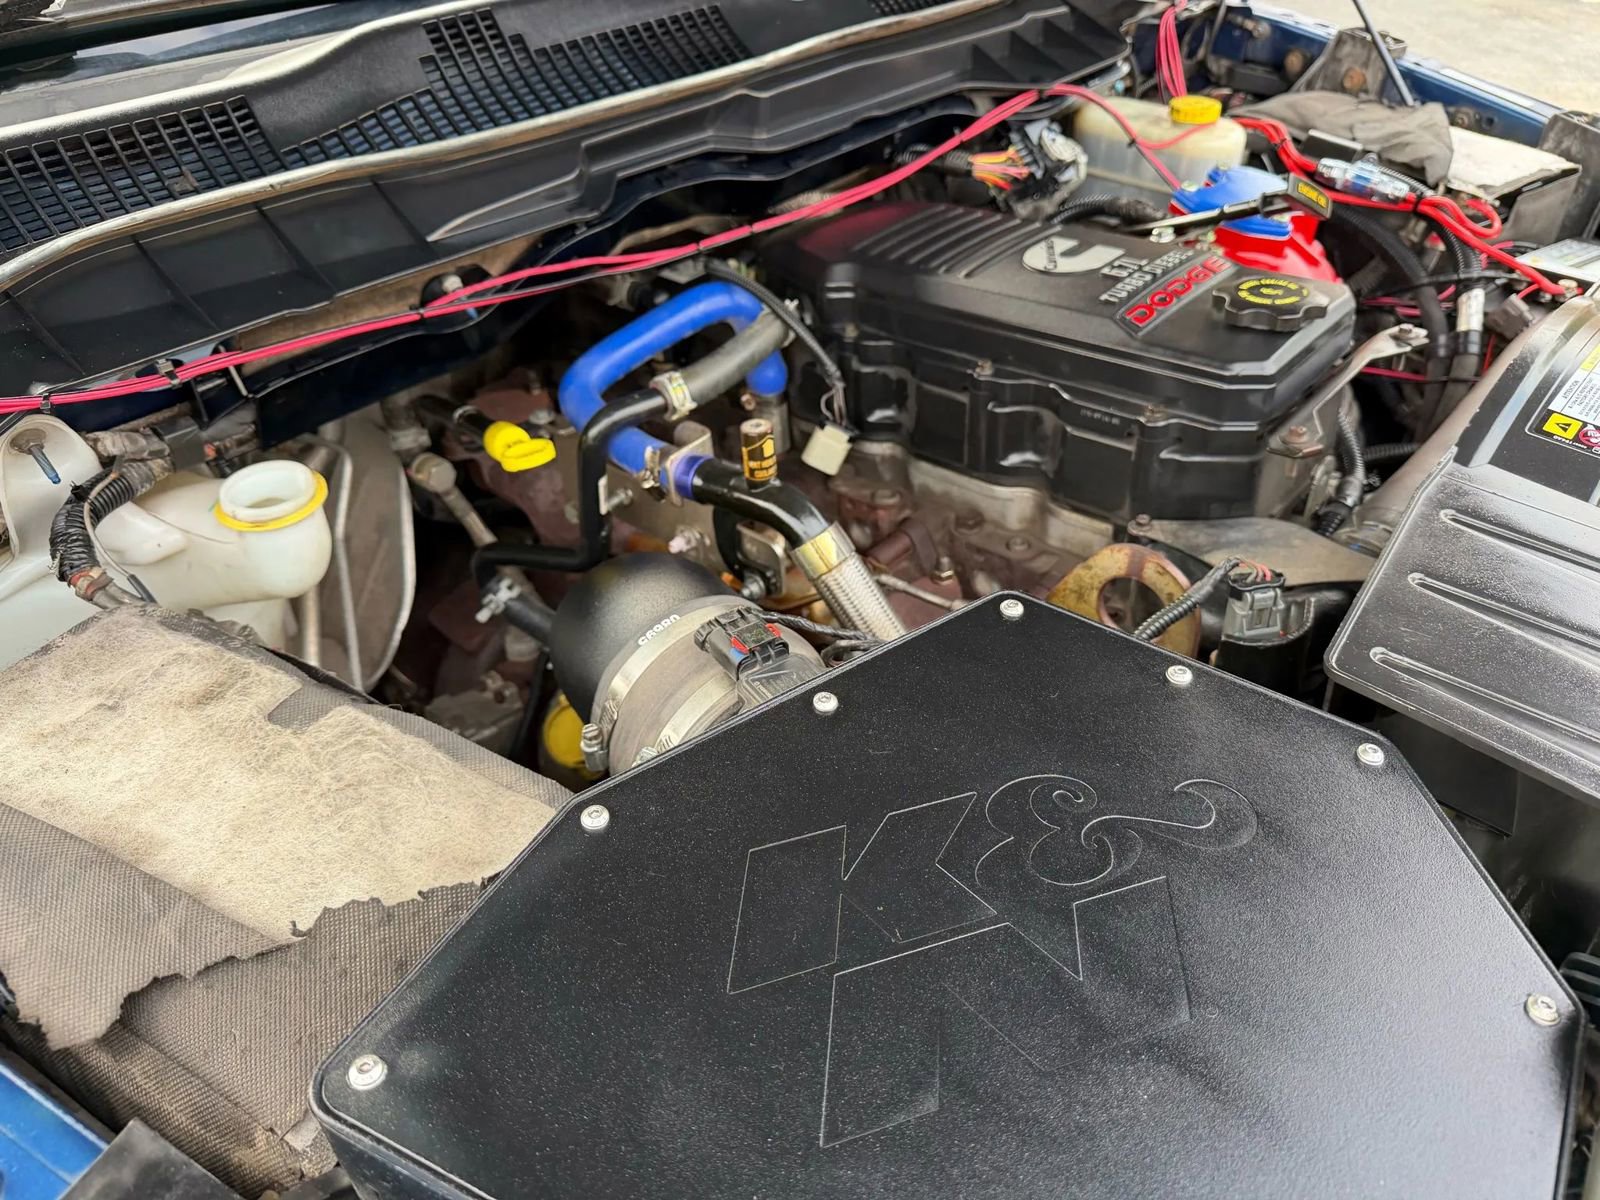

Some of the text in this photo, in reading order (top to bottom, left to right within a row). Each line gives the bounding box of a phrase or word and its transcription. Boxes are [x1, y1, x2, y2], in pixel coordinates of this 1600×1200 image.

[1099, 271, 1151, 302] TURBO
[1101, 257, 1149, 278] 6.7L
[1125, 255, 1233, 327] DODGE
[727, 774, 1259, 1148] K&N
